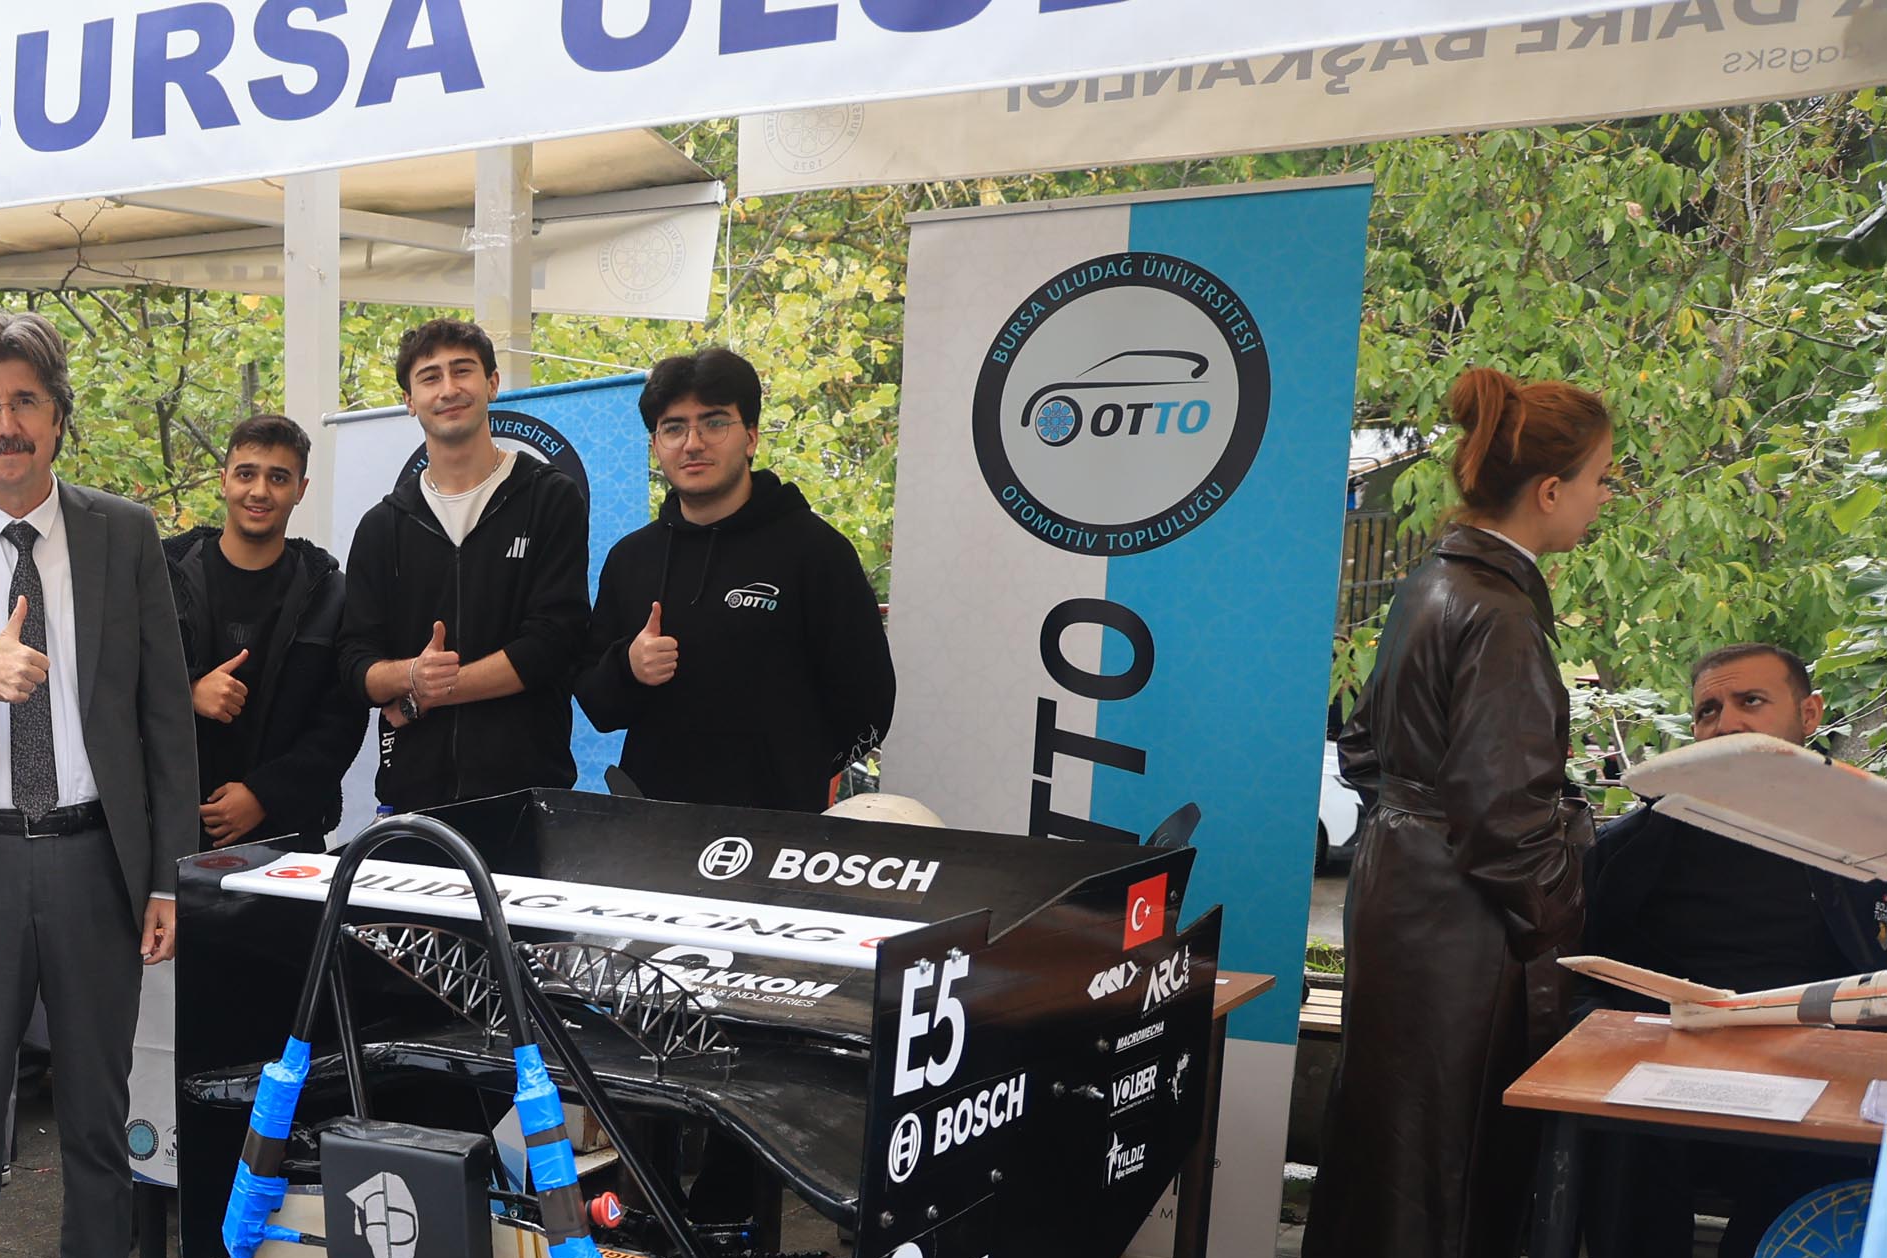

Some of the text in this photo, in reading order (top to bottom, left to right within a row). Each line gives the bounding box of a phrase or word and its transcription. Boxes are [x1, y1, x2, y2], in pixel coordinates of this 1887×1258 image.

[992, 254, 1262, 364] BURSA ULUDAĞ ÜNİVERSİTESİ
[1090, 400, 1211, 437] OTTO
[1002, 481, 1225, 550] OTOMOTİV TOPLULUĞU
[742, 595, 778, 611] OTTO
[1029, 597, 1155, 847] TTO
[768, 848, 941, 893] BOSCH
[1142, 951, 1185, 1012] ARC
[892, 953, 970, 1097] E5
[1115, 1020, 1165, 1051] MACROMECHA
[1112, 1064, 1158, 1108] VOLBER
[933, 1072, 1026, 1157] BOSCH
[1117, 1143, 1146, 1170] YILDIZ
